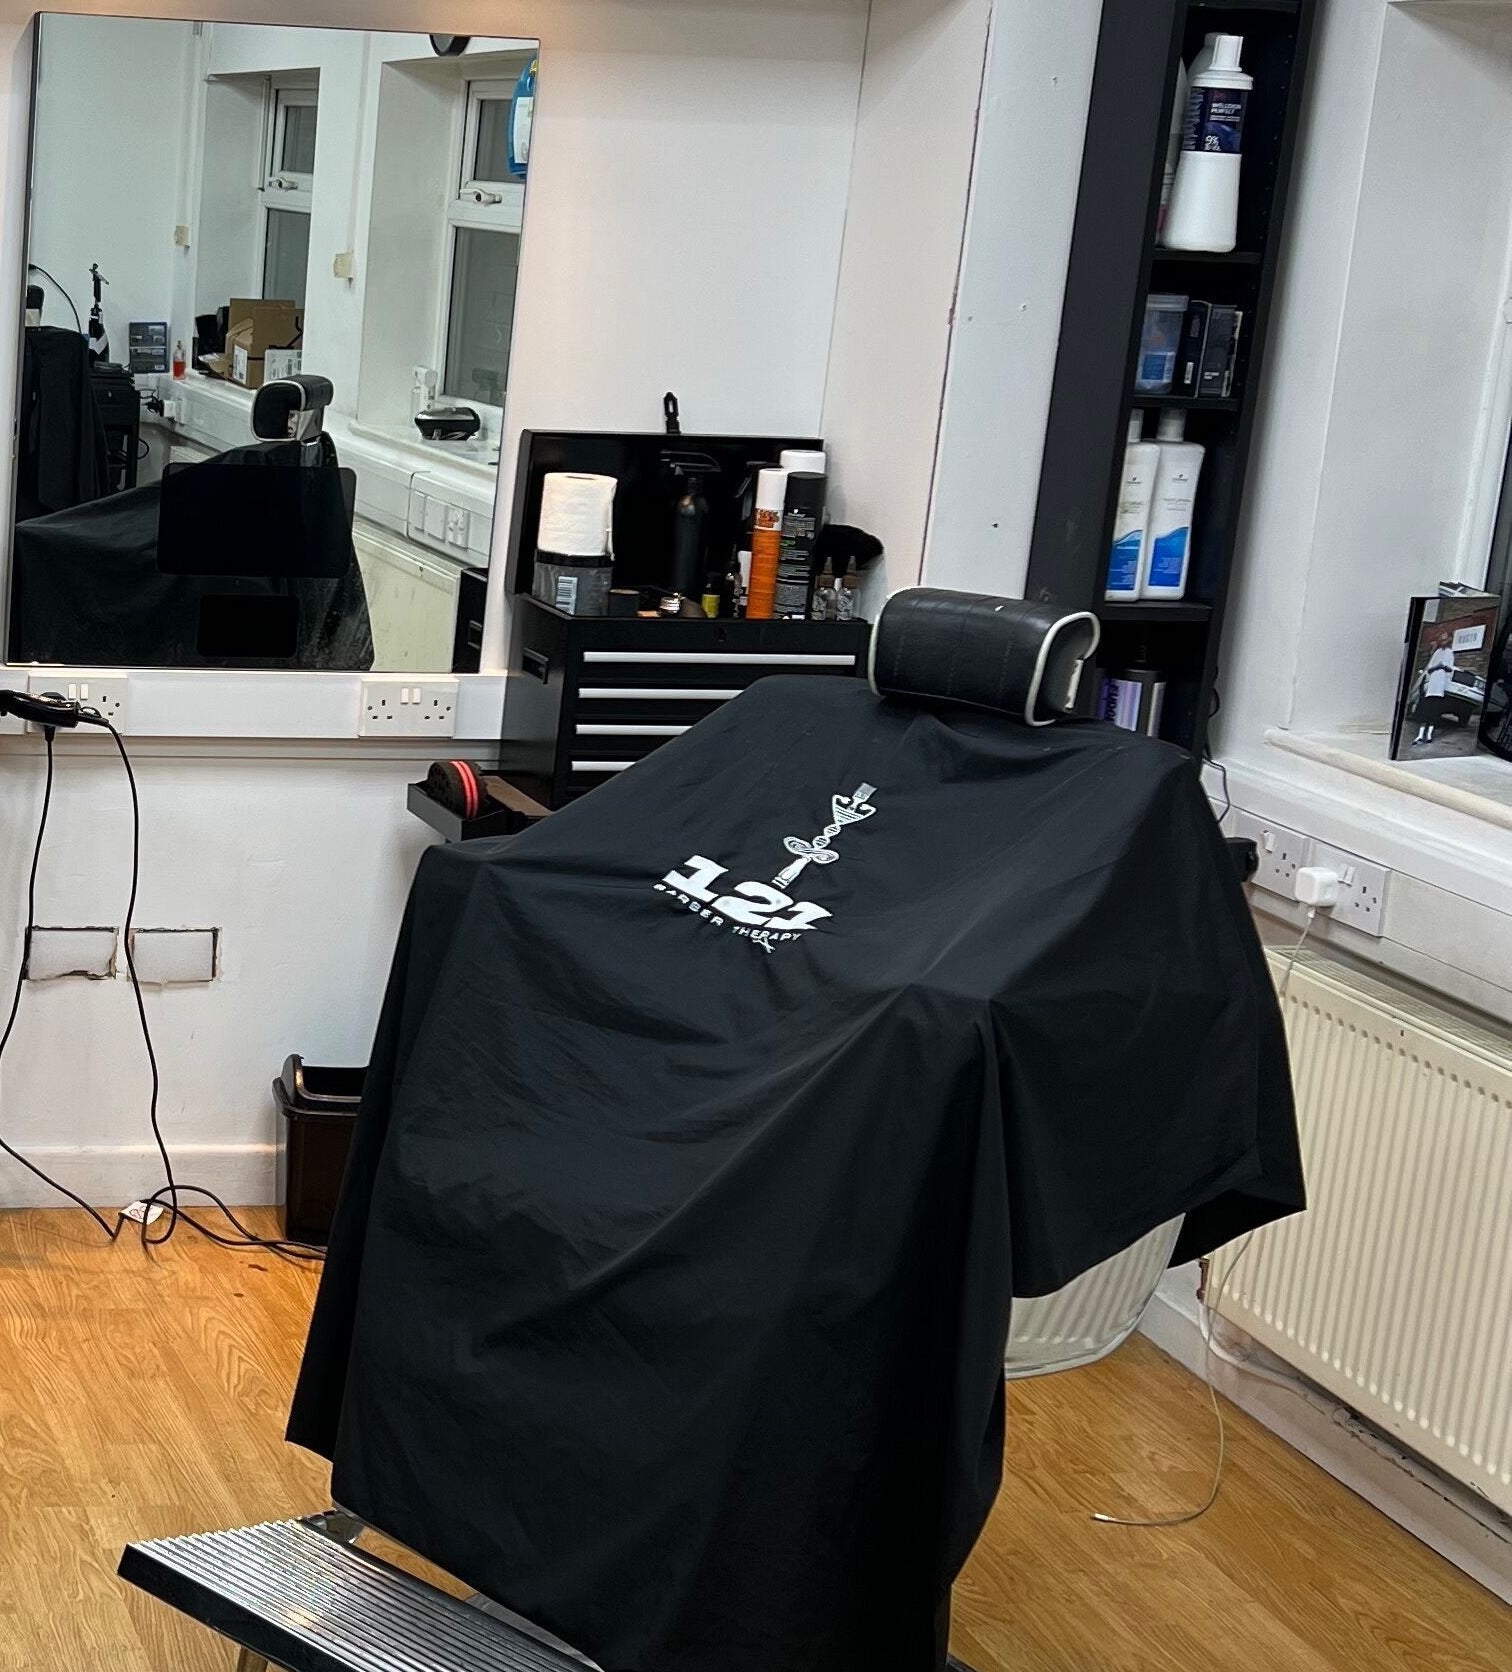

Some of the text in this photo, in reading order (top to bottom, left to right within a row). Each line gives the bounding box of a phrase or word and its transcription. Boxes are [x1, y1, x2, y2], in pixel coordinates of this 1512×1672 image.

[653, 883, 802, 942] BARBER THERAPY
[662, 855, 834, 930] 121
